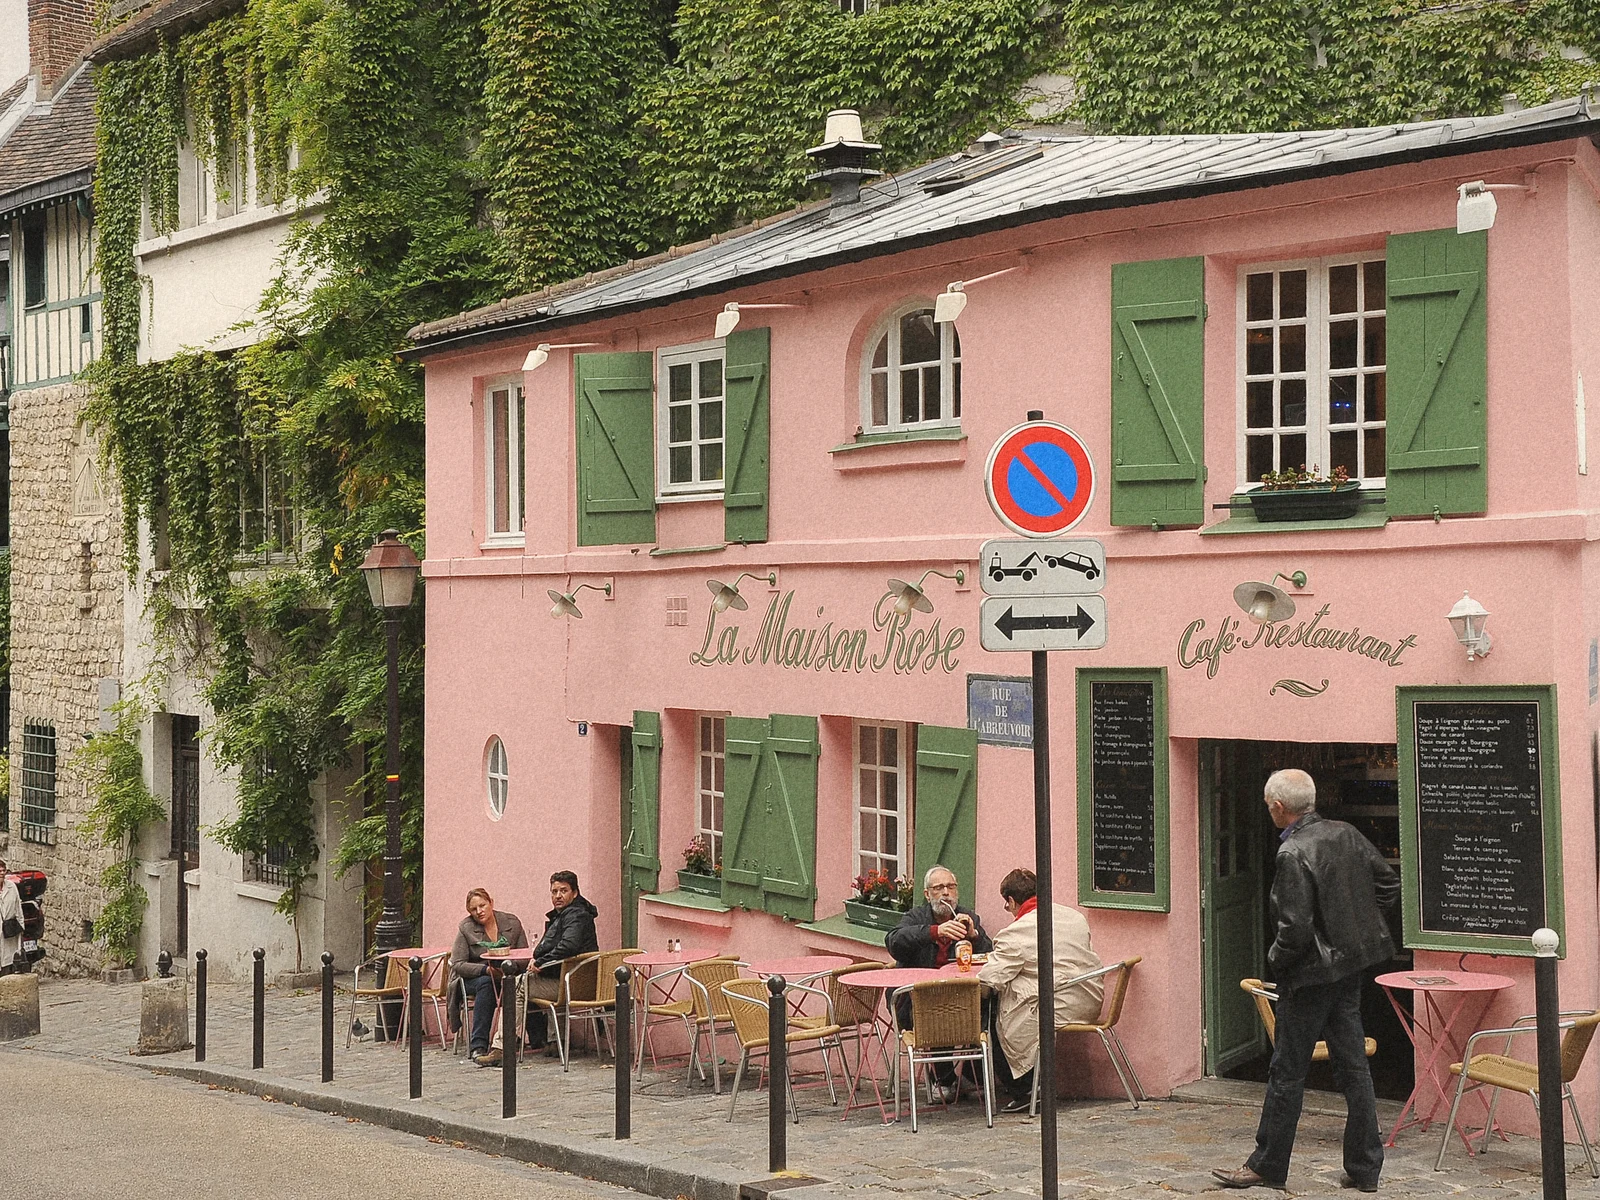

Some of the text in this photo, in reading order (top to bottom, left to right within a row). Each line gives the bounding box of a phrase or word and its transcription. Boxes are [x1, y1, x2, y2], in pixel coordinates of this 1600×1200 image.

[689, 589, 966, 675] La Maison Rose
[1242, 603, 1418, 667] Restaurant
[992, 688, 1012, 702] RUE
[995, 704, 1008, 718] DE
[580, 724, 585, 734] 2
[974, 717, 1031, 738] L'ABREUVOIR
